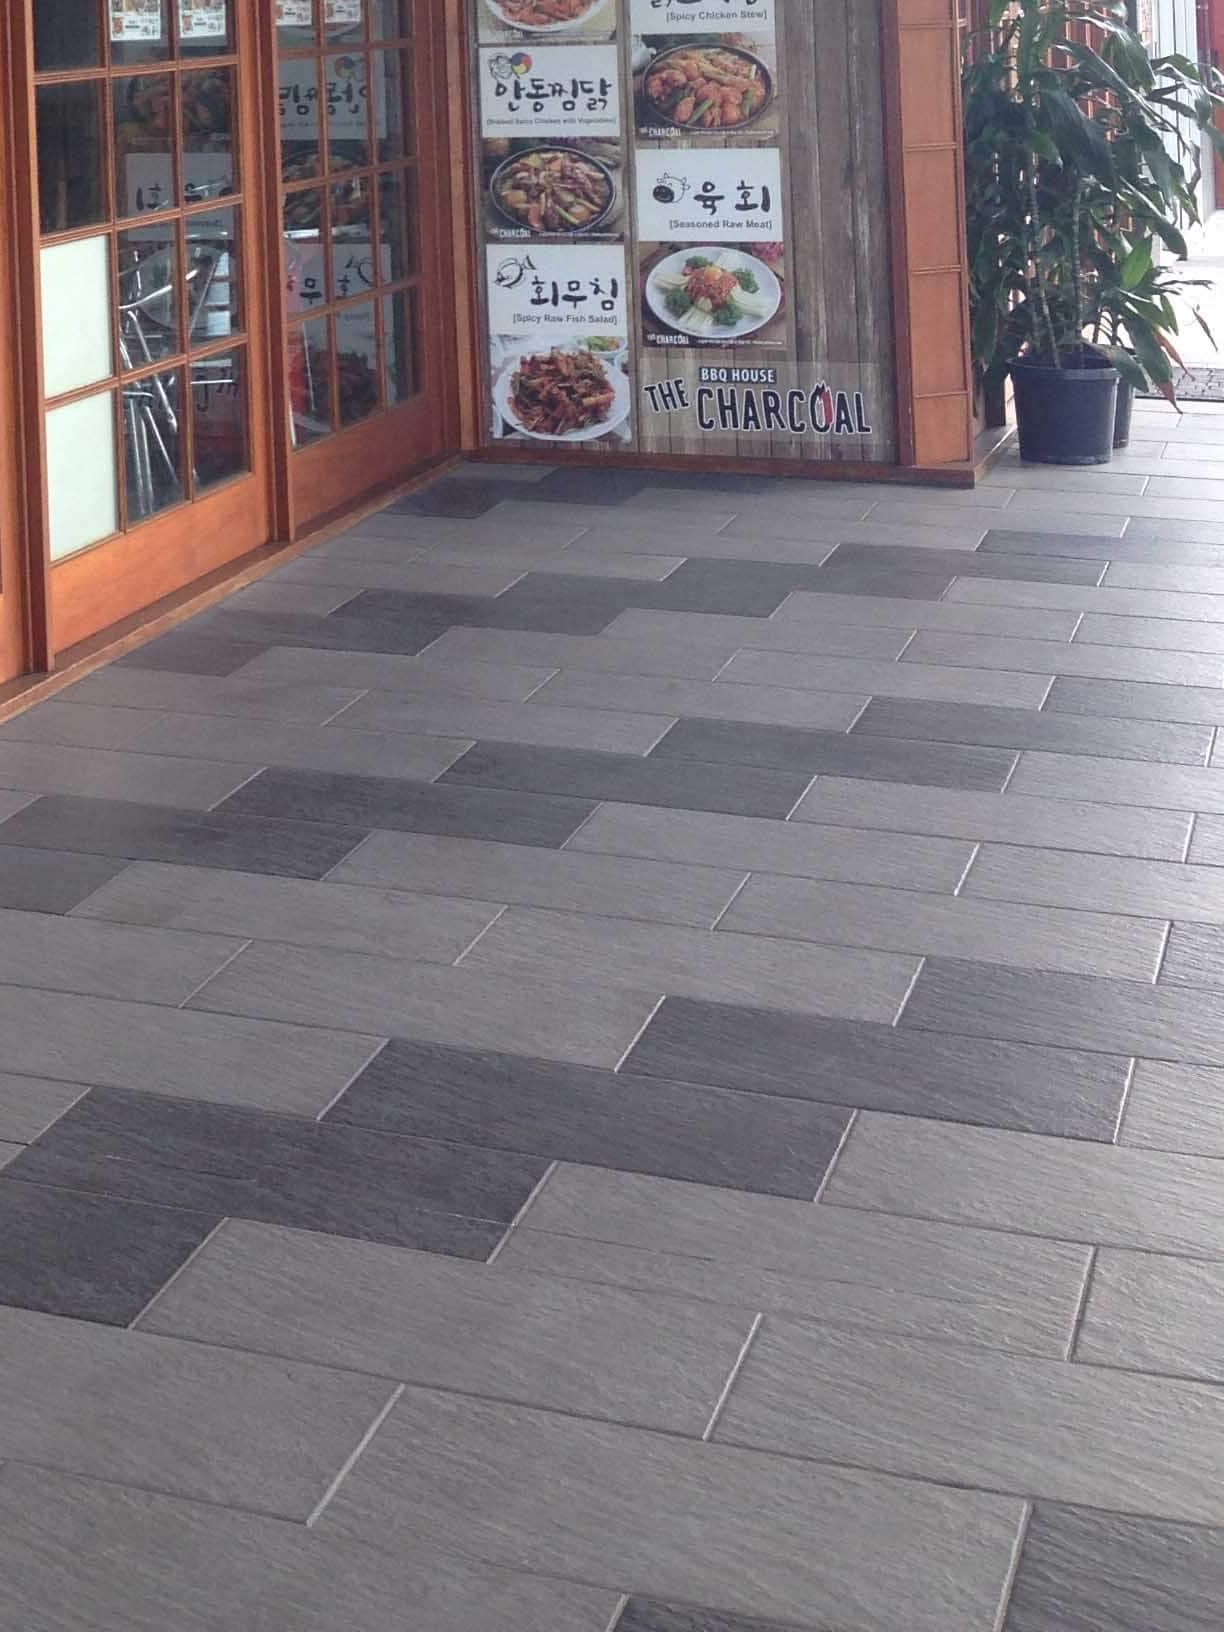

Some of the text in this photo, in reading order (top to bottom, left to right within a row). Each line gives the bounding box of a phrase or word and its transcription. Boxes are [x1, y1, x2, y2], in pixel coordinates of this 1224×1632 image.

[495, 77, 613, 113] 안동찜닭
[530, 275, 619, 311] 회무침
[701, 369, 775, 383] BBQ HOUSE
[643, 378, 690, 414] THE
[696, 379, 873, 436] CHARCOAL
